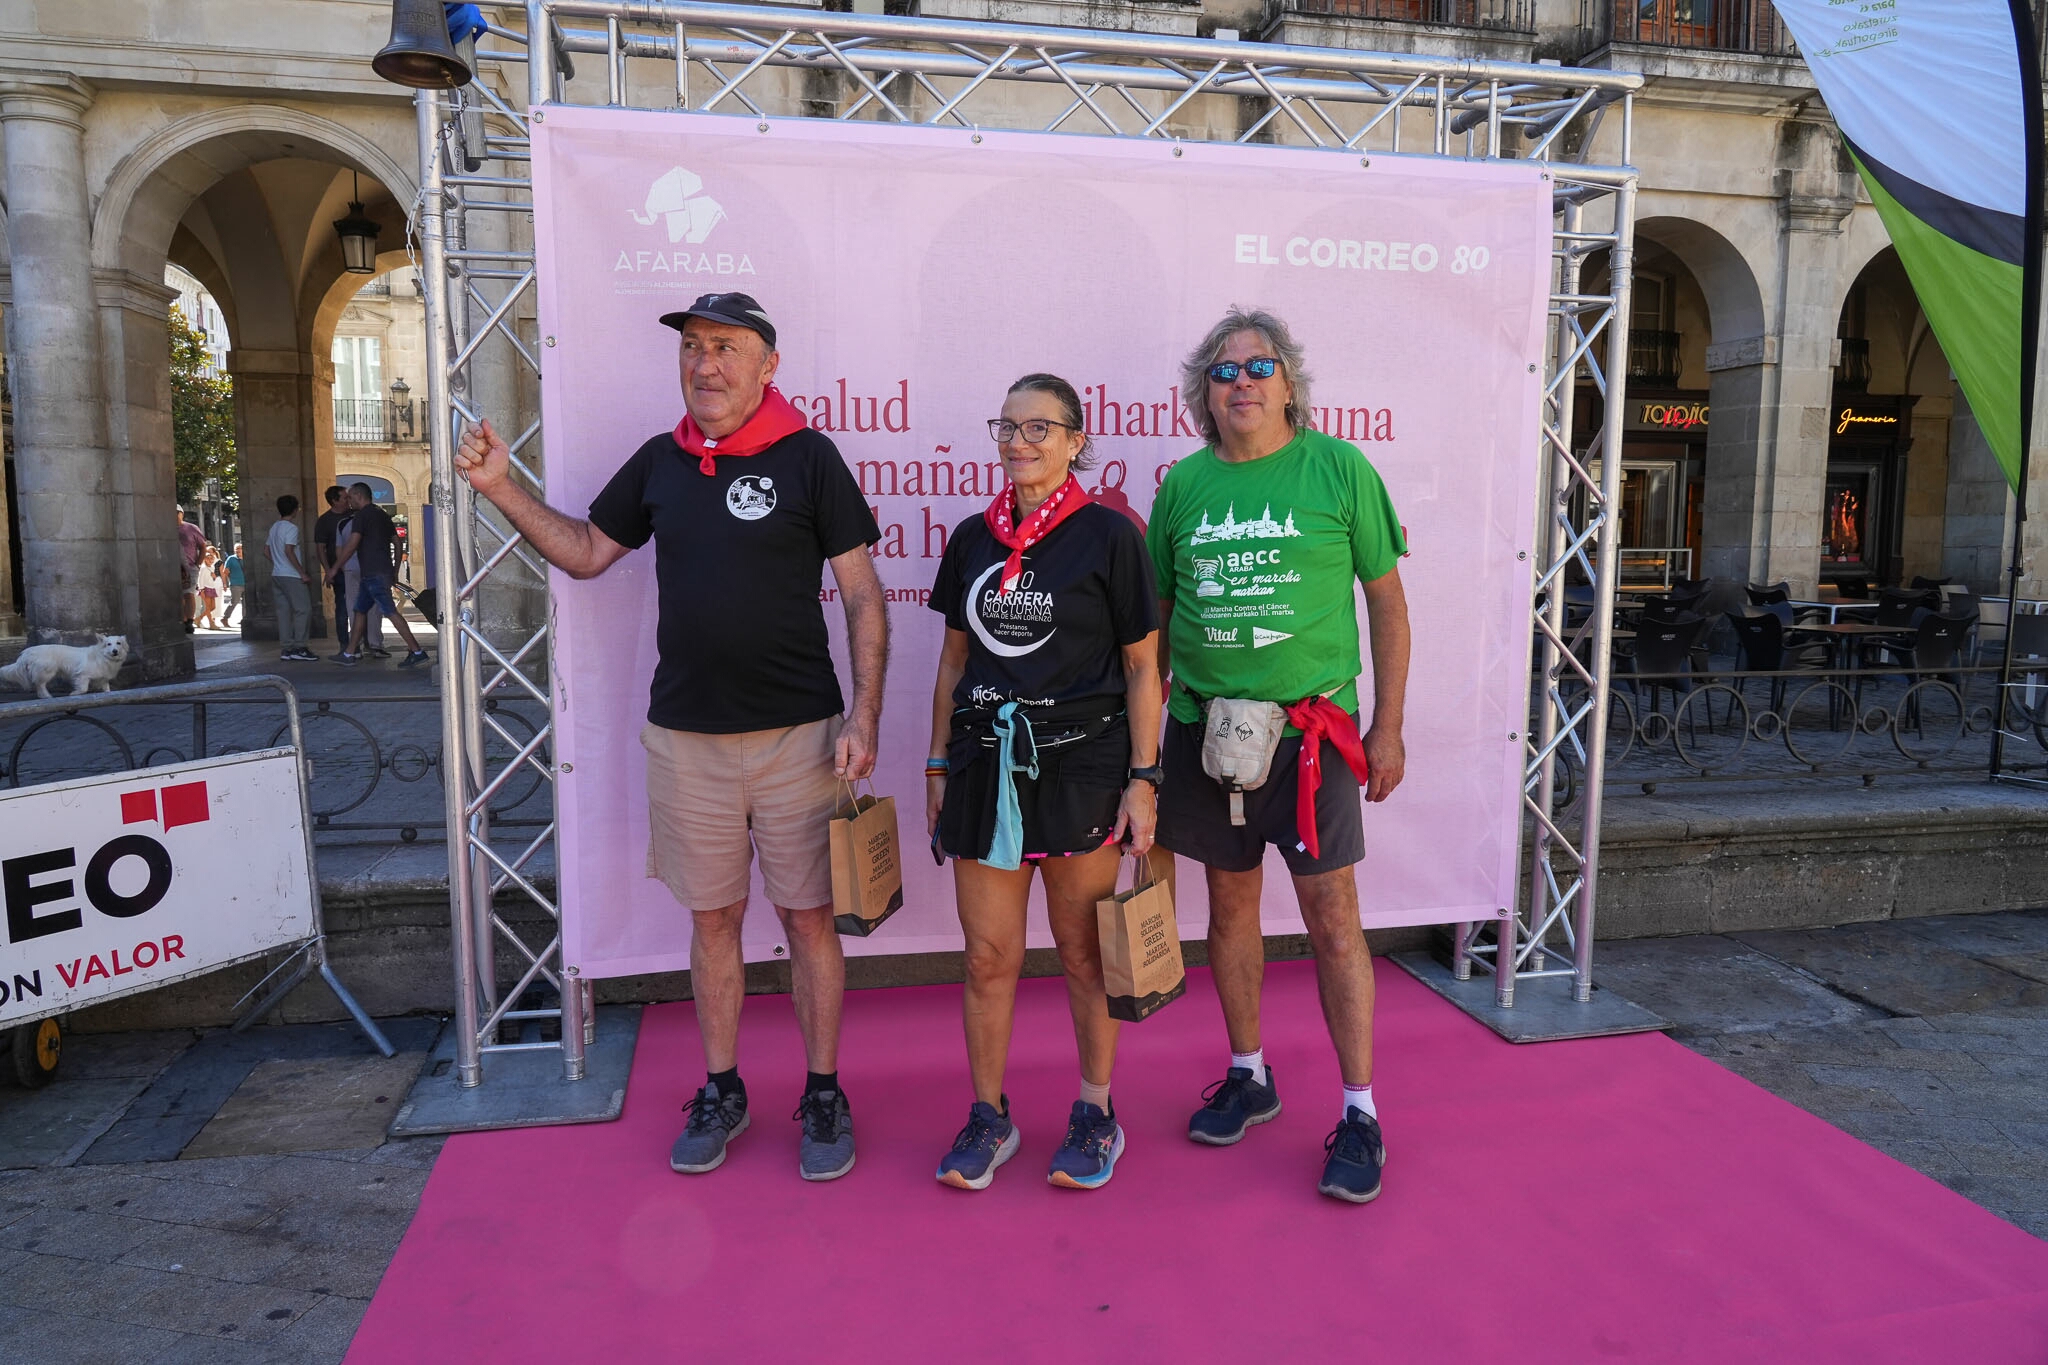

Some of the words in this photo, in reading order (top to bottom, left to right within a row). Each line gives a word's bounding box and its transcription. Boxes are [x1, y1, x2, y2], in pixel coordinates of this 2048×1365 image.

[614, 250, 757, 275] AFARABA
[1235, 234, 1280, 265] EL
[1286, 236, 1439, 272] CORREO
[1451, 245, 1490, 274] 80
[790, 377, 911, 433] salud
[1082, 383, 1203, 438] ihark
[855, 445, 1009, 497] mañan
[1227, 549, 1281, 567] aecc
[1230, 576, 1248, 586] en
[1252, 569, 1302, 584] marcha
[984, 589, 1054, 607] CARRERA
[1230, 583, 1276, 597] martxan
[982, 602, 1052, 616] NOCTURNA
[1233, 610, 1259, 618] aurkako
[994, 628, 1010, 636] hacer
[1011, 630, 1033, 638] deporte
[1000, 622, 1028, 631] Préstanos
[1204, 627, 1239, 642] Vital
[1144, 930, 1165, 948] GREEN
[56, 934, 186, 989] VALOR
